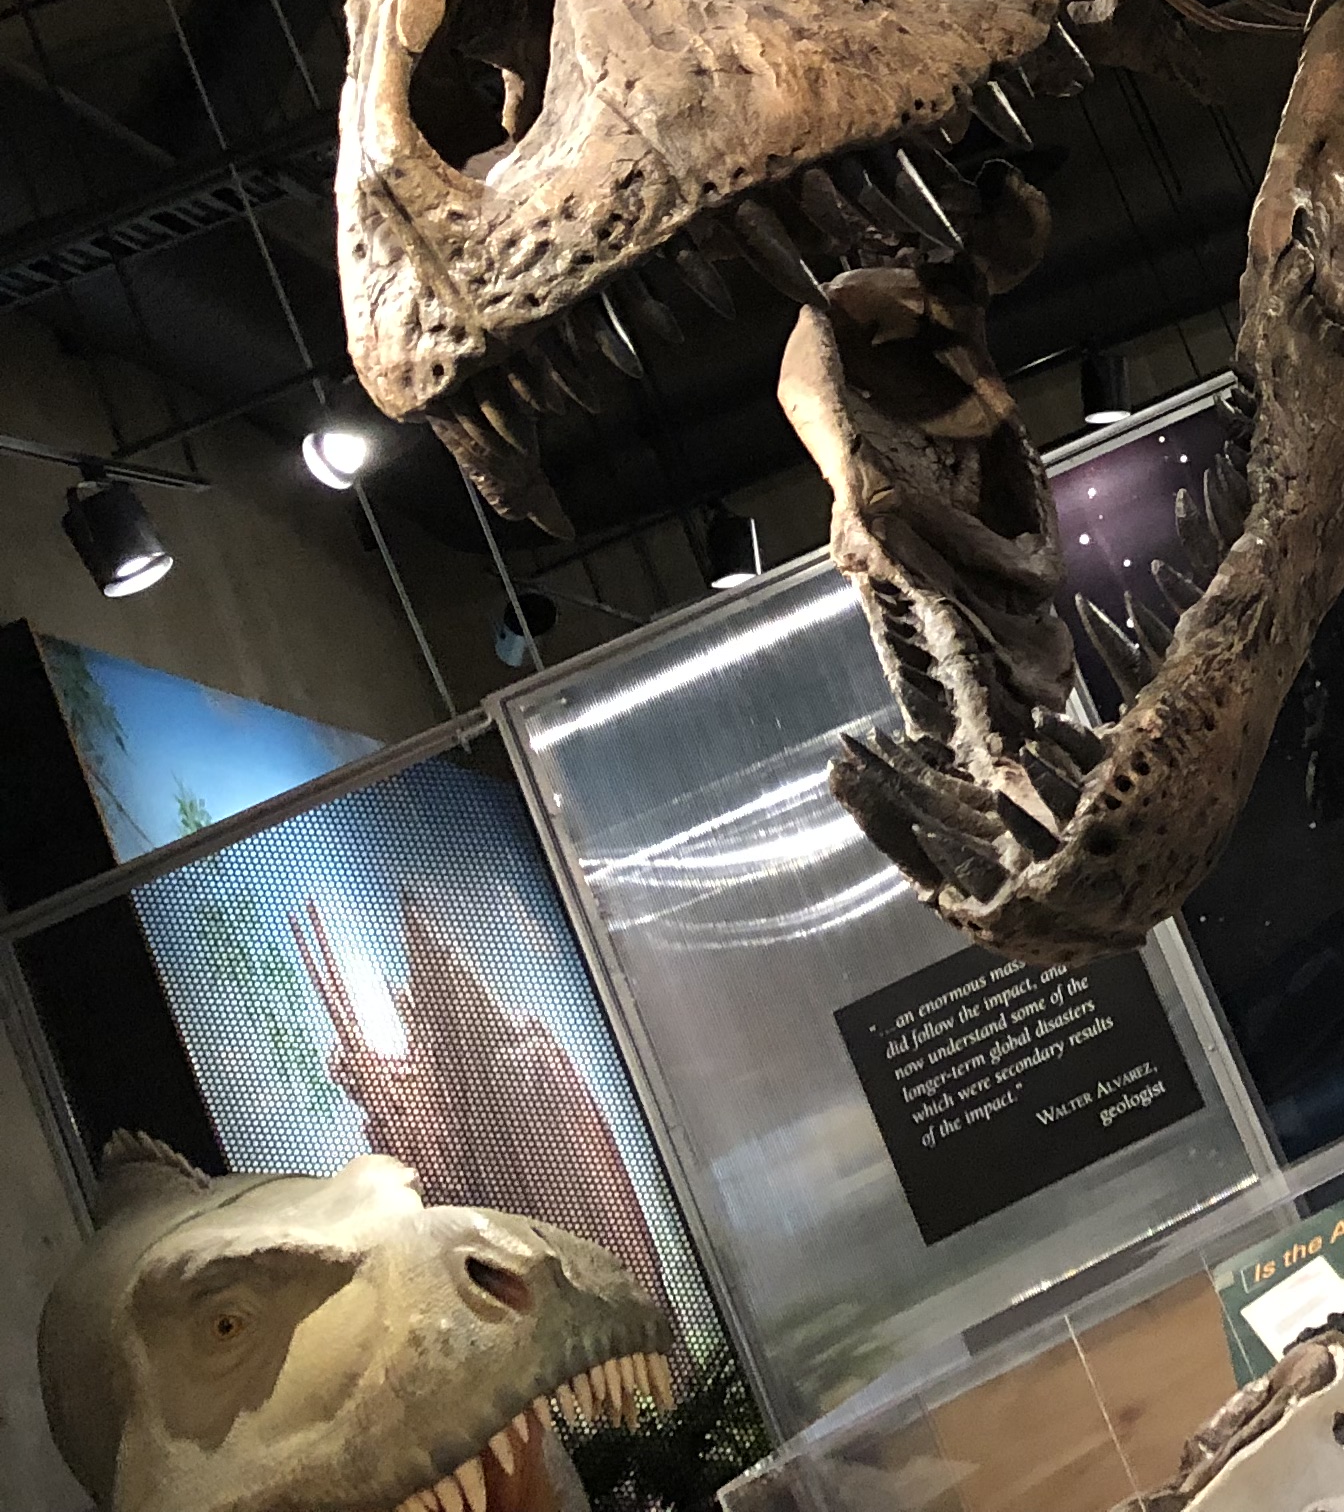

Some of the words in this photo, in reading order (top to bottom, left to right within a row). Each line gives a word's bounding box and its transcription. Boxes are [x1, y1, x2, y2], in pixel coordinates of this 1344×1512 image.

[886, 1035, 910, 1060] did
[911, 1016, 955, 1052] follow
[958, 1004, 981, 1024] the
[983, 978, 1038, 1008] impact,
[918, 975, 987, 1018] enormous
[894, 1056, 925, 1081] now
[927, 1012, 1008, 1066] understand
[1010, 997, 1047, 1024] some
[1049, 983, 1065, 1007] of
[1067, 976, 1090, 997] the
[901, 1052, 987, 1104] longer-term
[988, 1026, 1032, 1065] global
[1034, 999, 1096, 1039] disasters
[911, 1091, 955, 1125] which
[957, 1076, 992, 1101] were
[994, 1040, 1065, 1085] secondary
[1068, 1015, 1115, 1047] results
[1035, 1091, 1094, 1126] WALTER
[1099, 1079, 1167, 1128] geologist
[921, 1124, 937, 1149] of
[939, 1116, 963, 1138] the
[1253, 1258, 1277, 1283] Is
[1282, 1235, 1324, 1268] the
